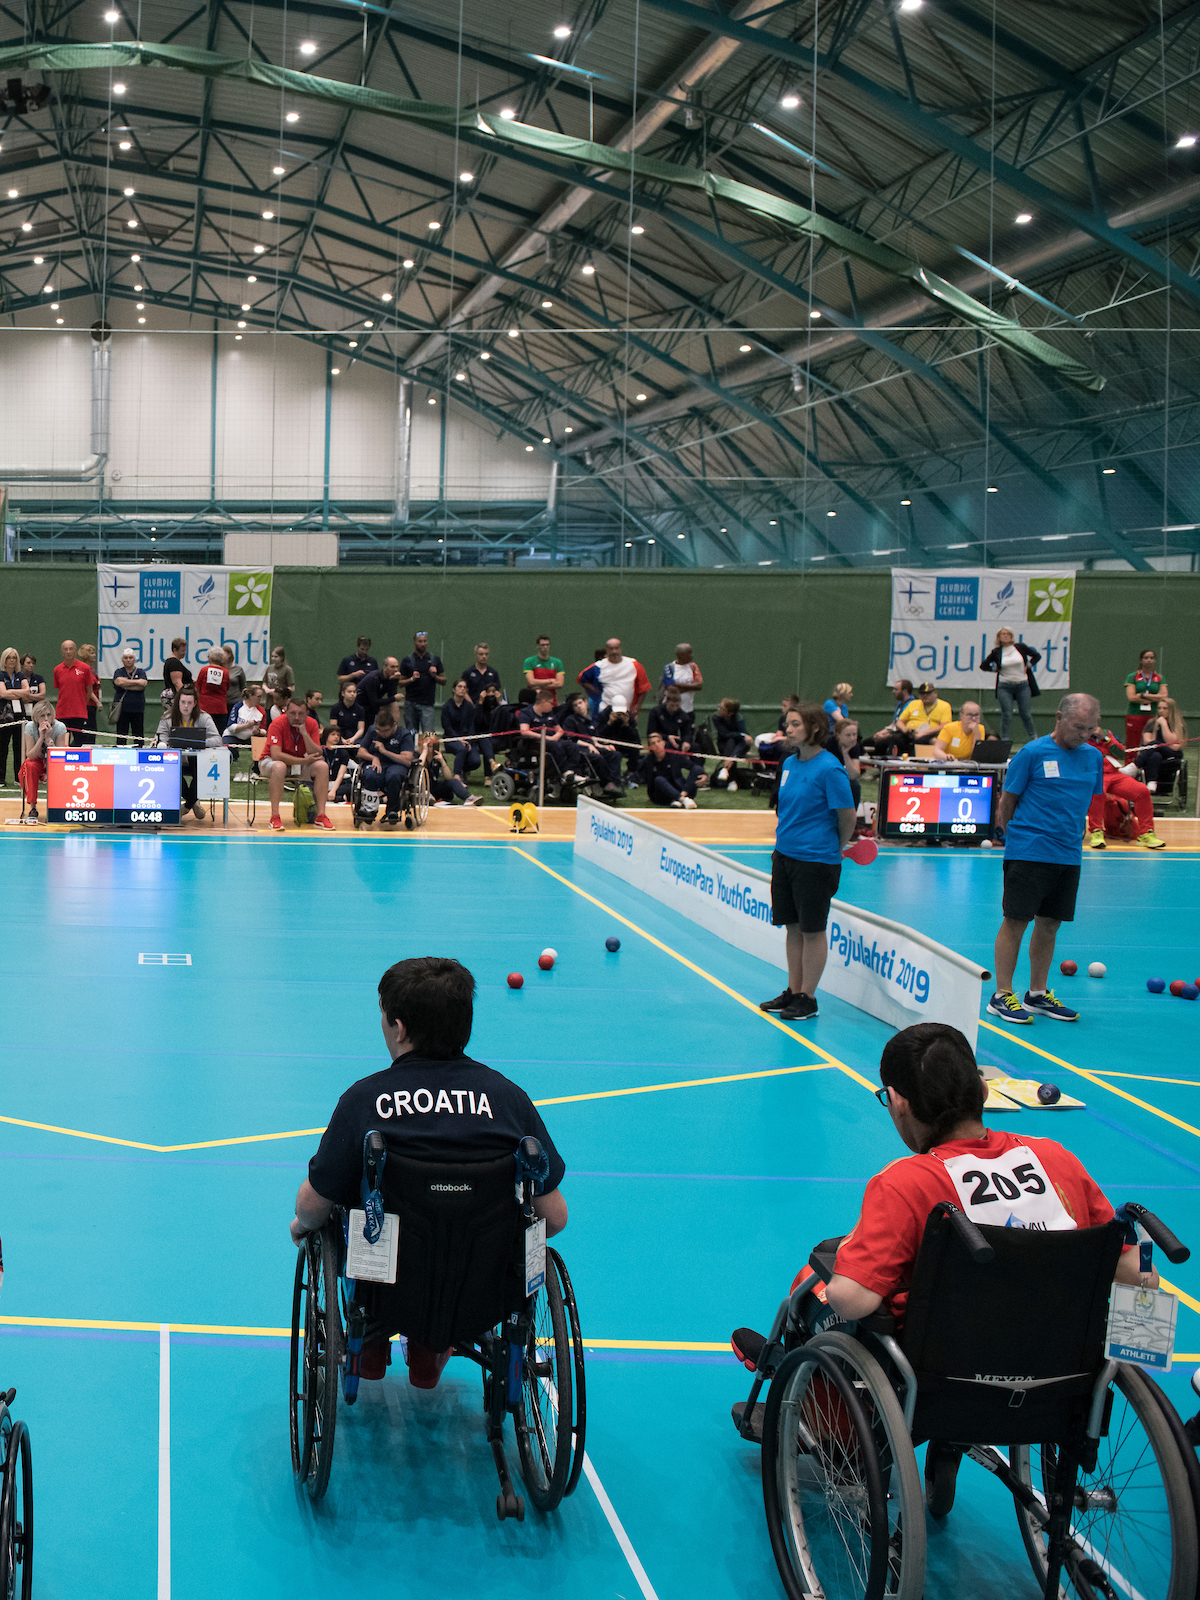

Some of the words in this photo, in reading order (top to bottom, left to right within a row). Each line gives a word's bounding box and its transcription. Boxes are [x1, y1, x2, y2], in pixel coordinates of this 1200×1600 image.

[143, 578, 173, 587] OLYMPIC
[143, 589, 176, 598] TRAINING
[143, 600, 169, 609] CENTER
[889, 631, 1069, 680] Pajulti
[66, 753, 79, 761] RUS
[207, 764, 220, 781] 4
[72, 777, 89, 804] 3
[138, 778, 156, 804] 2
[363, 793, 378, 803] 107
[65, 810, 97, 821] 05:10
[906, 797, 921, 818] 2
[958, 798, 972, 819] 0
[130, 811, 163, 822] 04:48
[590, 815, 617, 847] Pajulahti
[617, 830, 634, 856] 2019
[899, 823, 926, 833] 02:45
[951, 824, 977, 834] 02:50
[660, 847, 714, 895] EuropeanPara
[717, 873, 782, 929] YouthGame
[830, 922, 896, 980] Pajulahti
[896, 958, 930, 1003] 2019
[375, 1088, 494, 1119] CROATIA
[962, 1162, 1046, 1206] 205
[1120, 1348, 1156, 1362] ATHLETE
